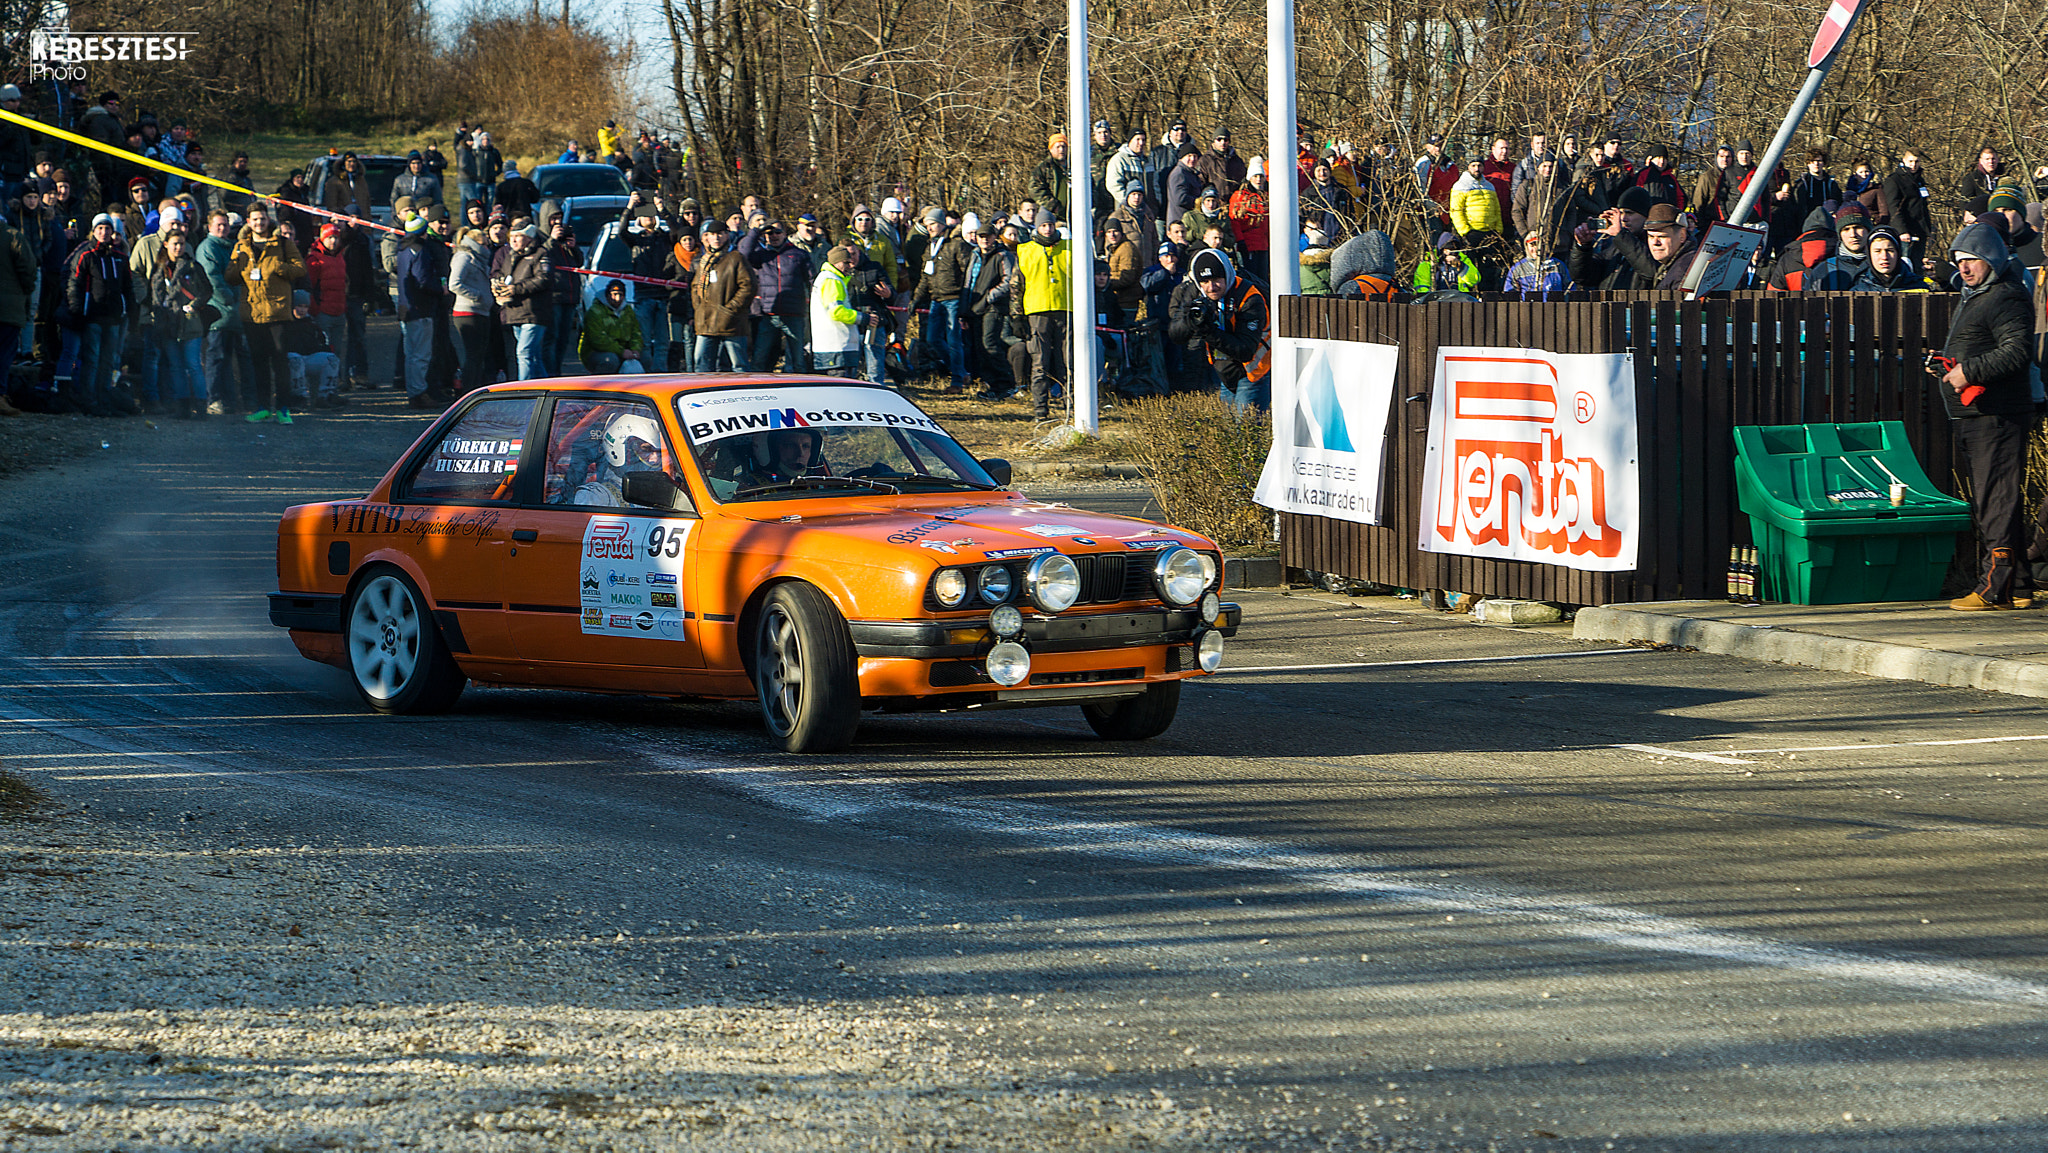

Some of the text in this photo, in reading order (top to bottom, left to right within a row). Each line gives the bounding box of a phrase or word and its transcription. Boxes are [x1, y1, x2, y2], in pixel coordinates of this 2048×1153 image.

[441, 438, 510, 455] TÖREKI B
[435, 457, 503, 473] HUSZÁR R
[1437, 356, 1622, 558] Penta
[332, 505, 404, 533] VHTB
[587, 520, 685, 560] Penta 95
[1003, 547, 1054, 556] MICHELIN
[611, 593, 642, 605] MAKOR
